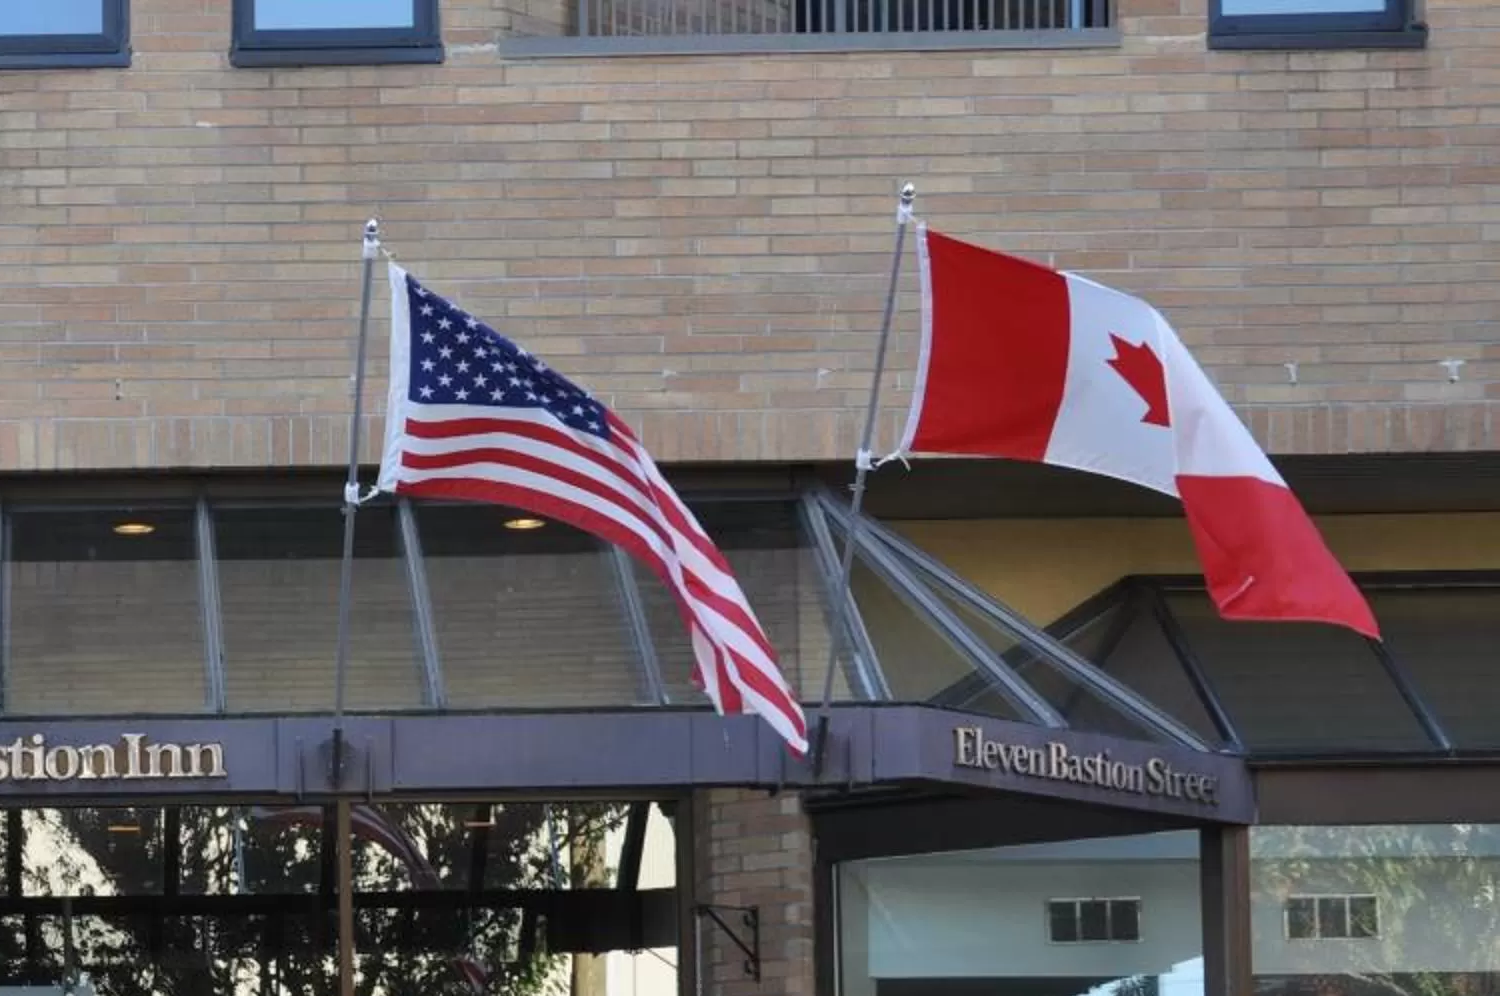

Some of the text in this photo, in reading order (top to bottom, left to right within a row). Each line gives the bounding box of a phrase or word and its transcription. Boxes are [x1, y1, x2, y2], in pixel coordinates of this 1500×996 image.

[121, 733, 228, 779] Inn
[955, 727, 1046, 777] Eleven
[1048, 742, 1144, 792] Bastion
